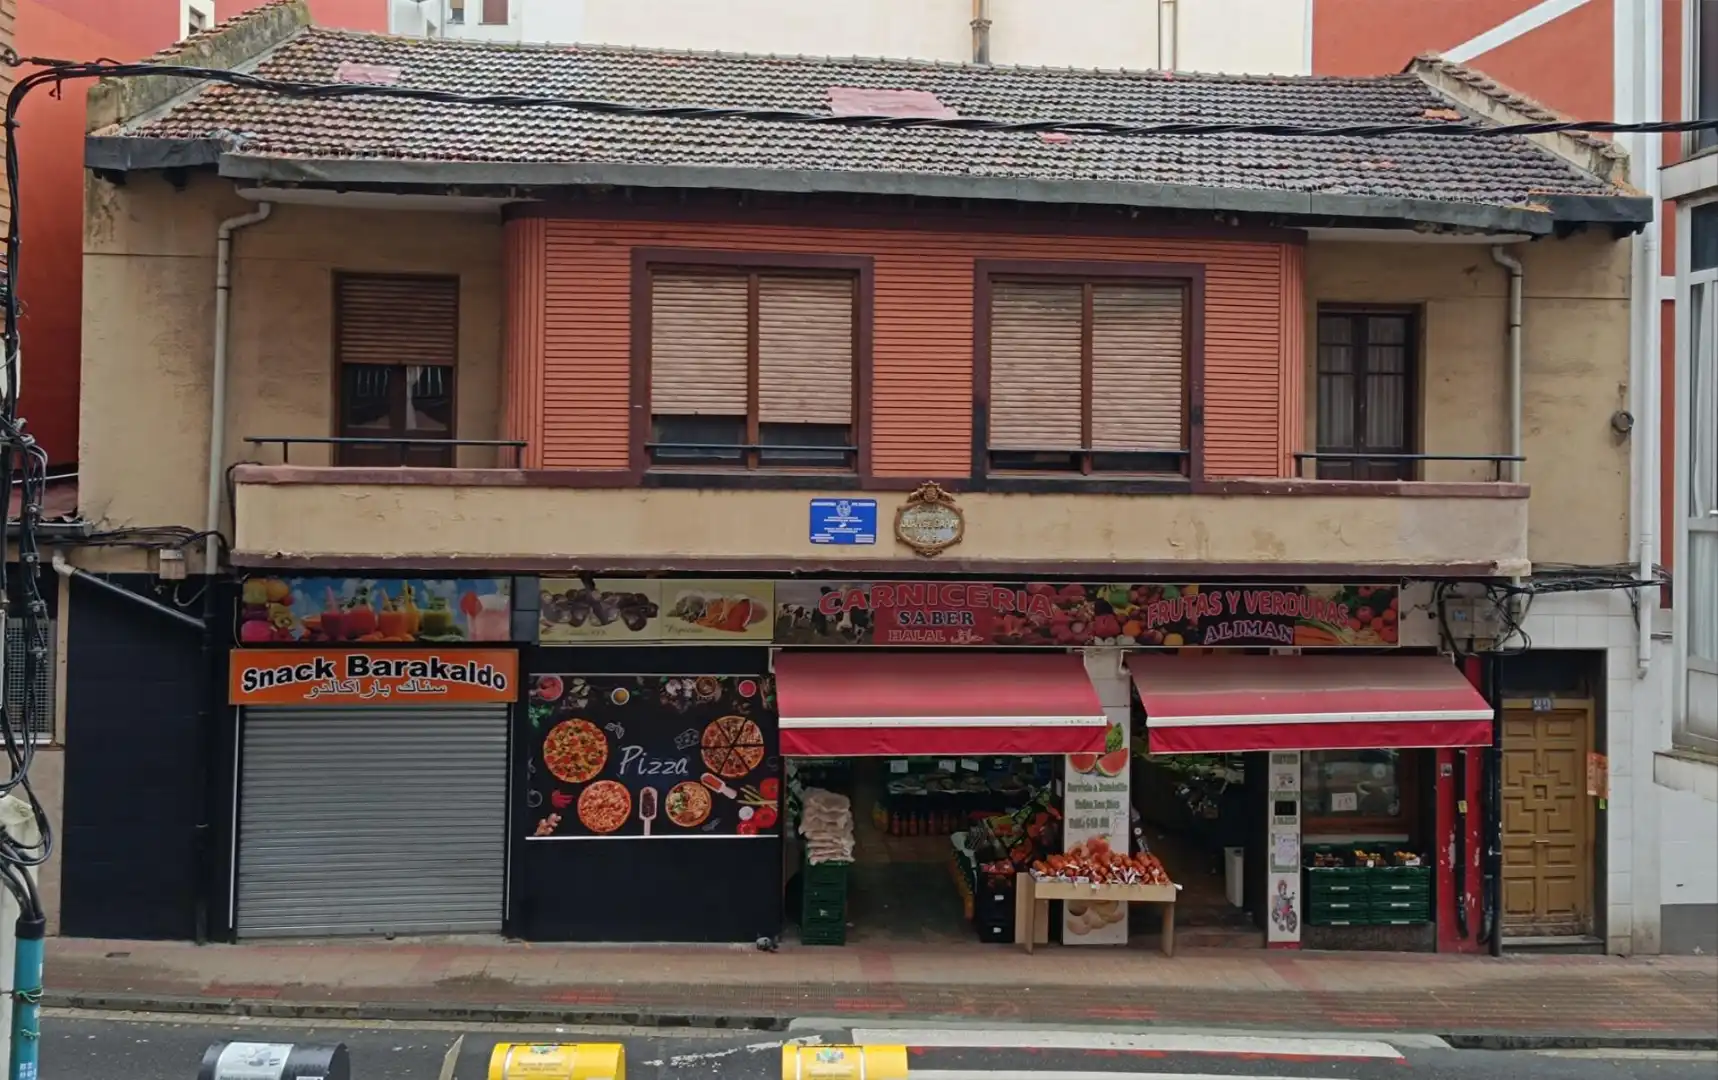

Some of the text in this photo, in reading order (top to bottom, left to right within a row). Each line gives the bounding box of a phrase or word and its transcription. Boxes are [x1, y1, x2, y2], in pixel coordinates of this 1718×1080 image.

[818, 584, 1052, 618] CARNICERIA
[1147, 590, 1349, 629] FRUTAS Y VERDURAS
[899, 610, 975, 626] SABER
[1204, 620, 1295, 645] ALIMAN
[888, 629, 946, 642] HALAL
[242, 654, 507, 692] Snack Barakaldo
[619, 744, 690, 776] Pizza
